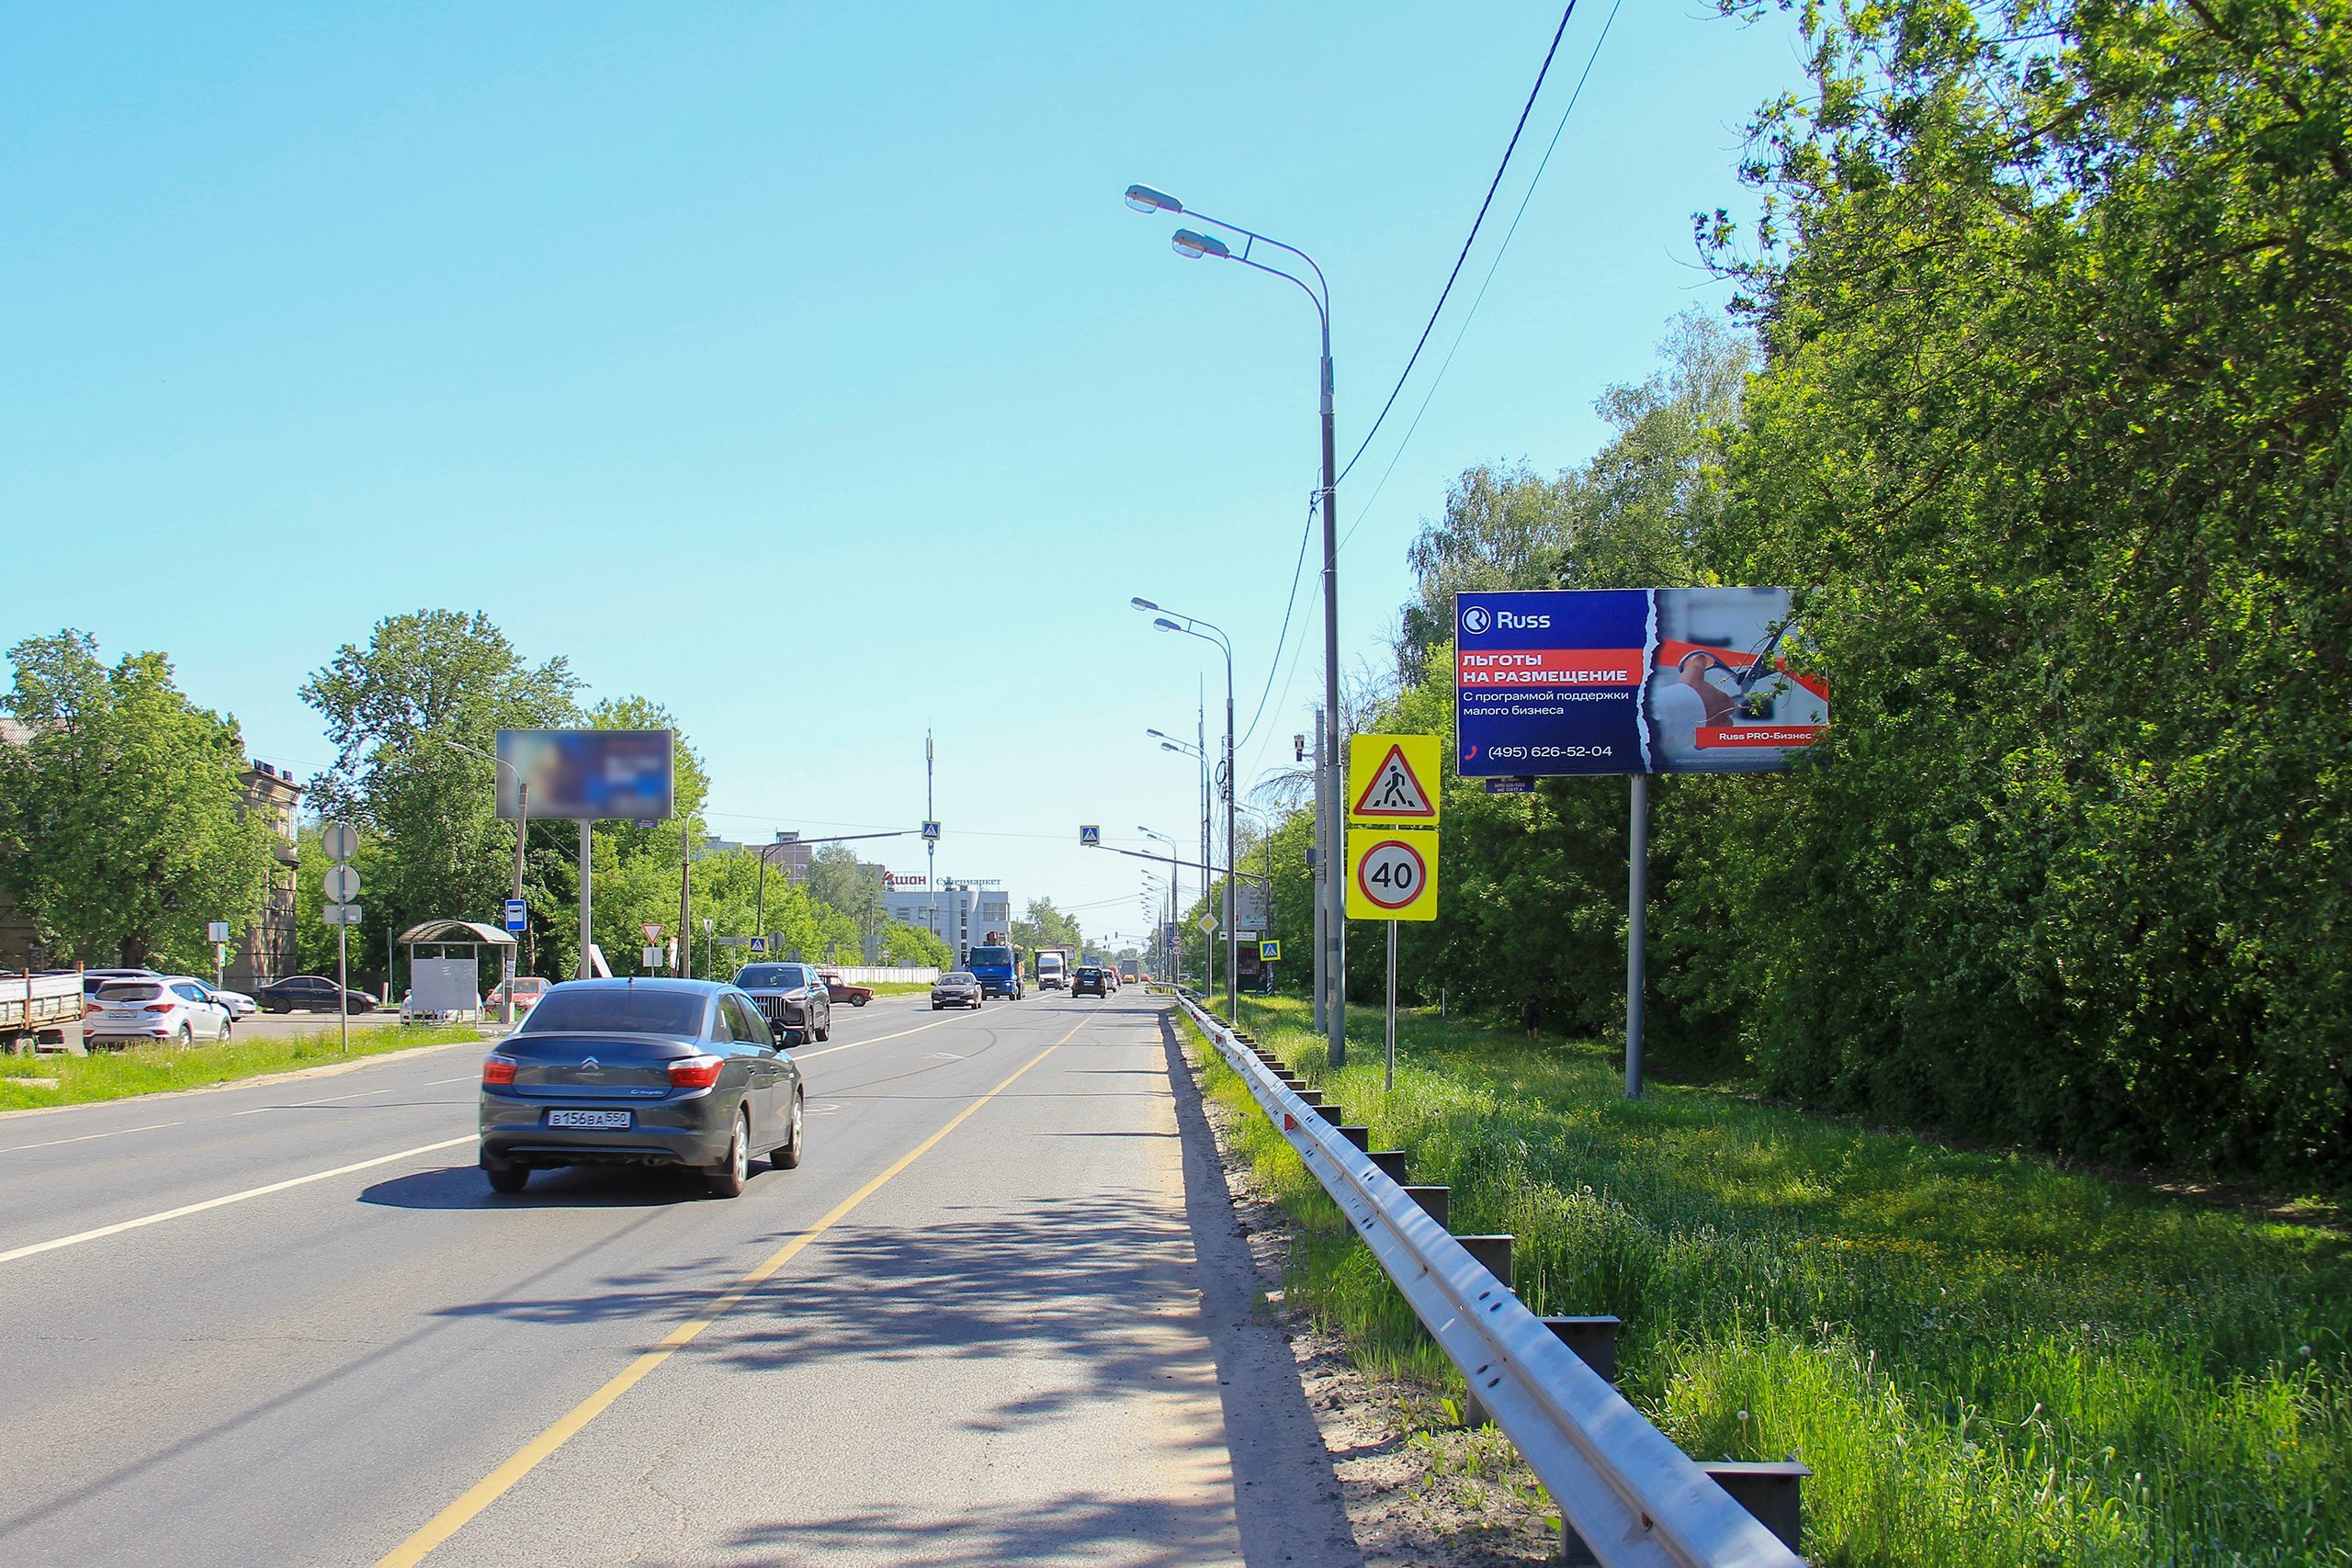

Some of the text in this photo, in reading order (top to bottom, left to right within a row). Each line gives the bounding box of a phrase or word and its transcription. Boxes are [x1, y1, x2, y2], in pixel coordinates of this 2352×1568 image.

[1497, 611, 1551, 629] Russ
[1462, 654, 1543, 666] ЛЬГОТЫ
[1463, 670, 1628, 683] НА РАЗМЕЩЕНИЕ
[1463, 691, 1629, 704] С программой поддержки
[1463, 705, 1565, 716] малого бизнеса
[1719, 731, 1812, 740] Russ PRO-Бизнес
[1488, 746, 1612, 761] (495) 626-52-04
[1371, 862, 1412, 889] 40
